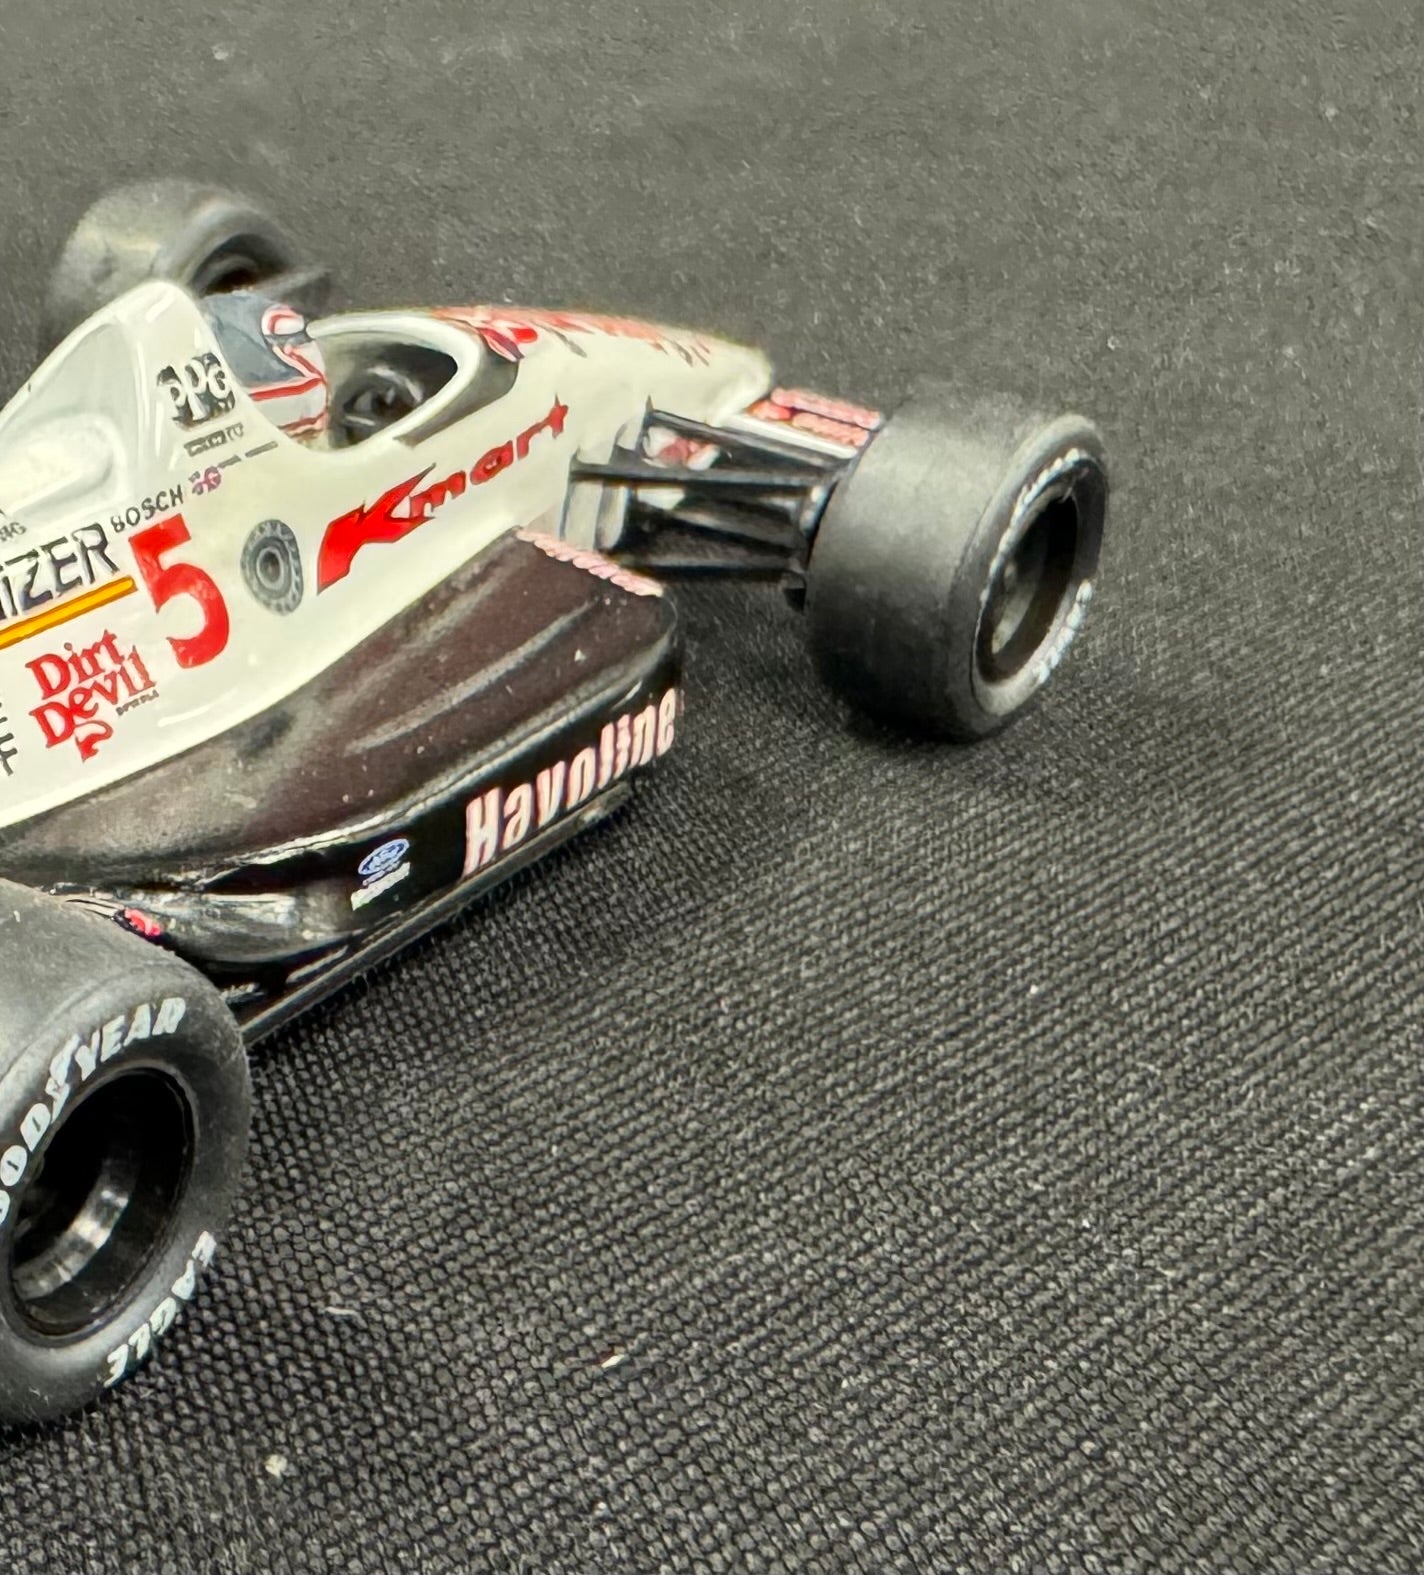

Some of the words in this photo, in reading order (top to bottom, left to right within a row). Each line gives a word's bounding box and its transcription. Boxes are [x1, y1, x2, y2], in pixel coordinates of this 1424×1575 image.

[110, 484, 184, 533] BOSCH
[316, 394, 569, 595] Kmart
[25, 629, 124, 700] Dirt
[129, 513, 230, 669] 5
[28, 645, 156, 749] Devil
[463, 687, 682, 880] Havoline
[103, 1230, 217, 1389] EAGLE
